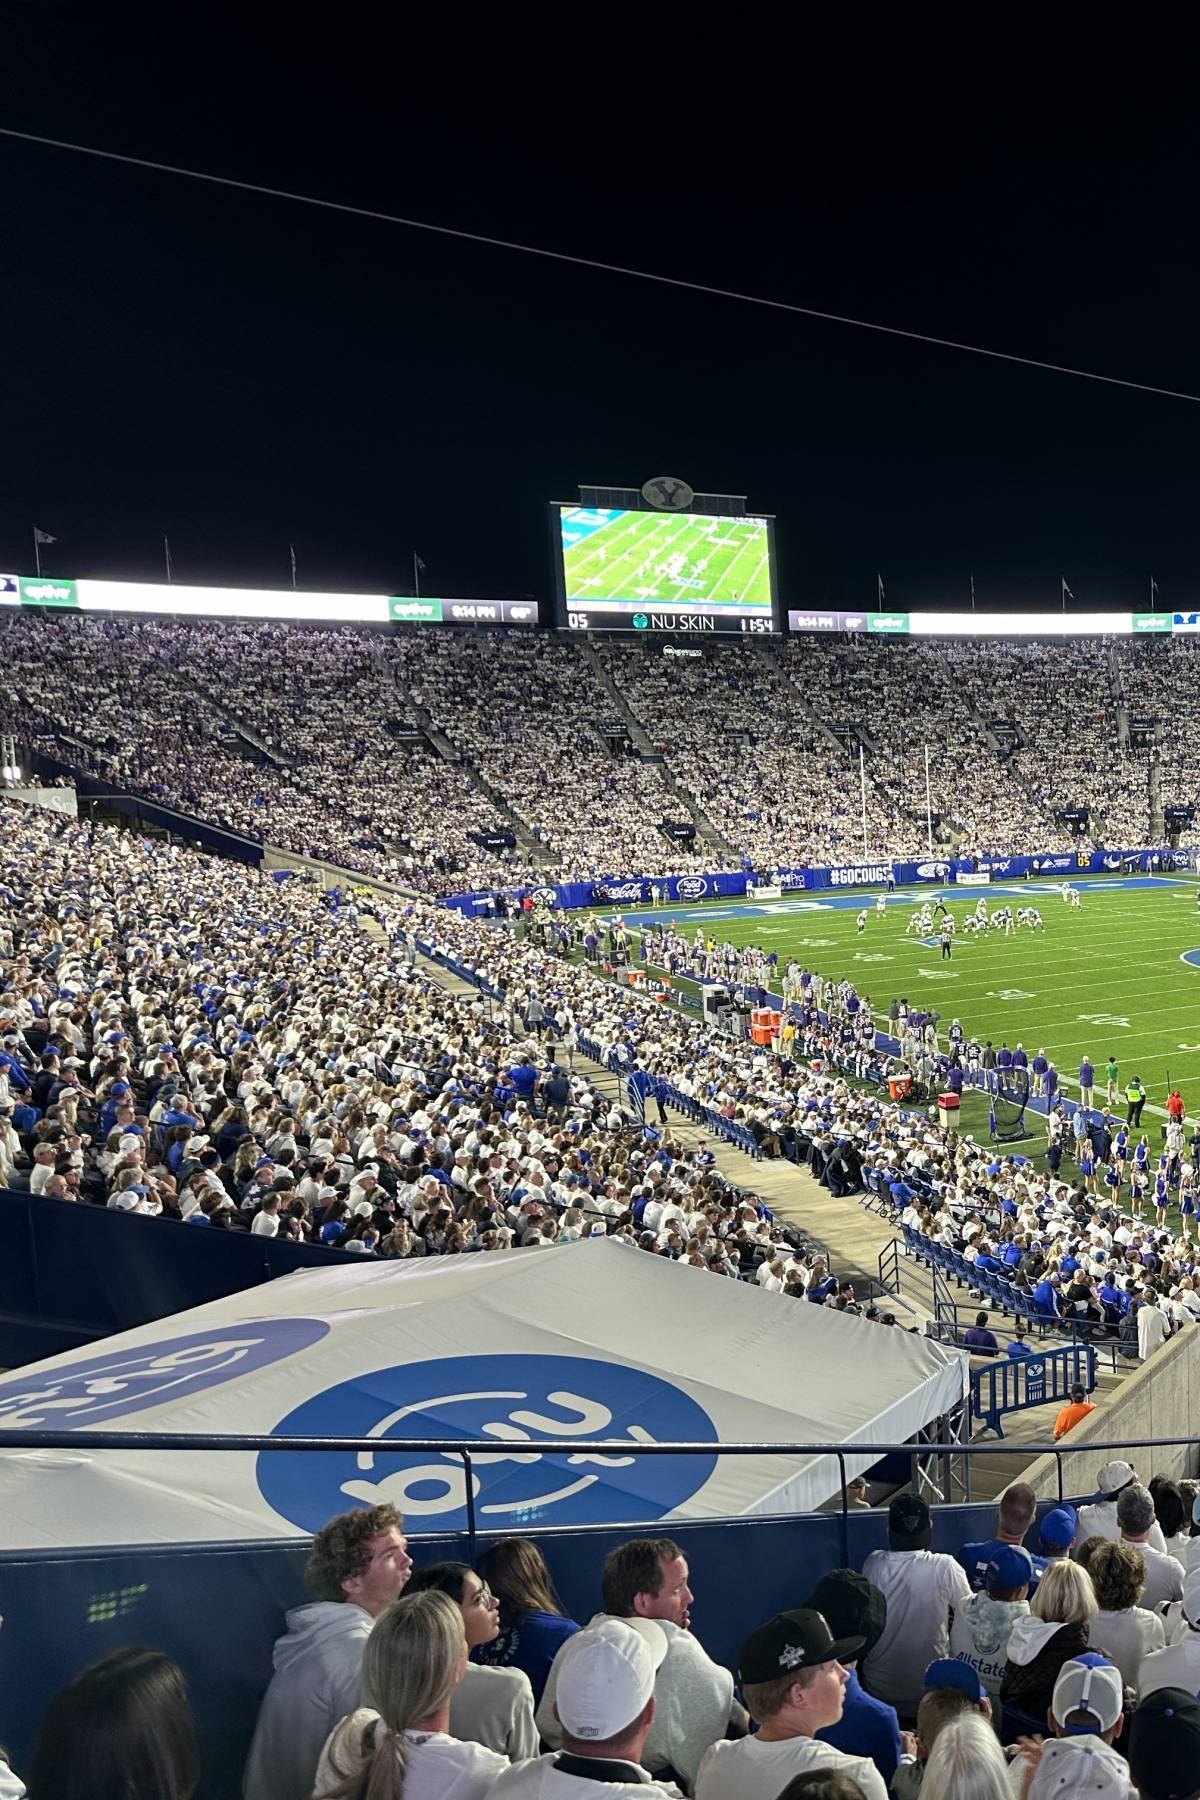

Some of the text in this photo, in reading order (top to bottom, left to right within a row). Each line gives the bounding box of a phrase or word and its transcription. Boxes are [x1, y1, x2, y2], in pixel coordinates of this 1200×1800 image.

[651, 480, 685, 506] Y
[568, 613, 589, 628] 05
[651, 614, 715, 631] NU SKIN
[741, 619, 773, 632] 11:54
[1077, 857, 1090, 866] 05
[956, 1651, 1006, 1678] Allstate
